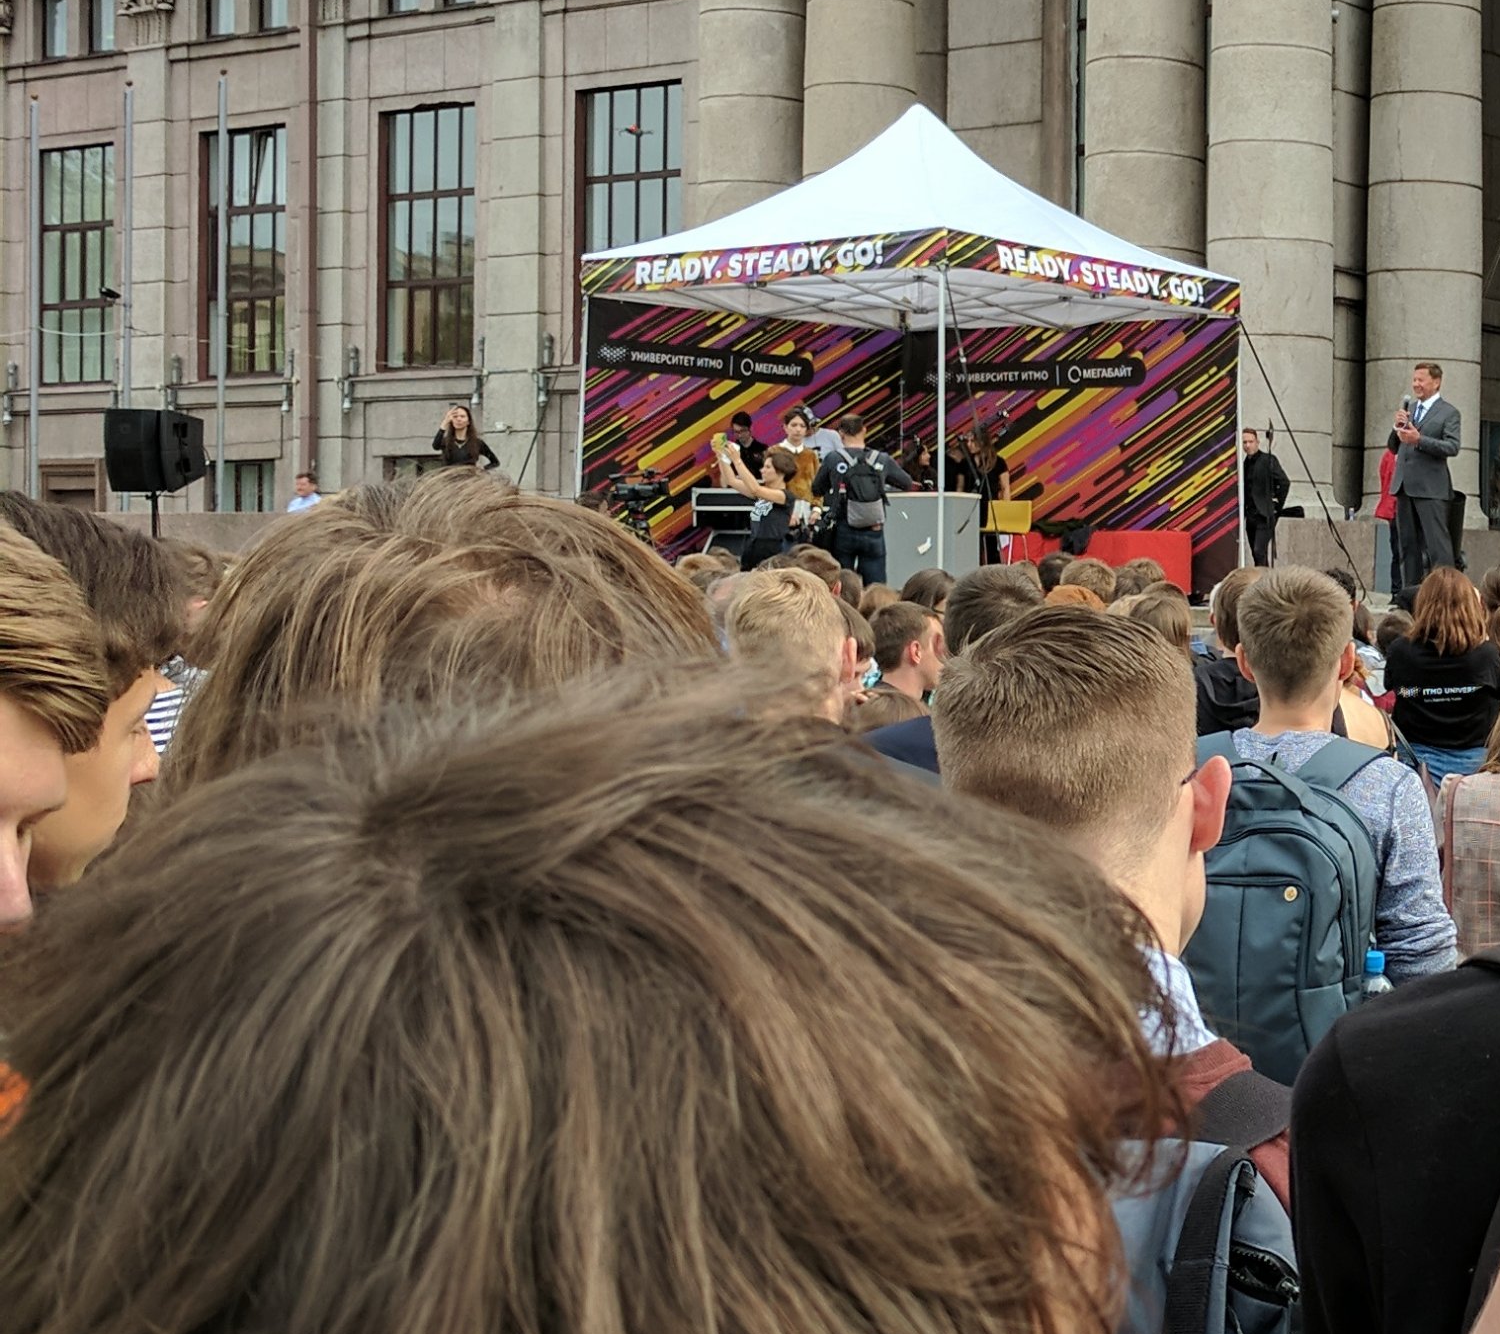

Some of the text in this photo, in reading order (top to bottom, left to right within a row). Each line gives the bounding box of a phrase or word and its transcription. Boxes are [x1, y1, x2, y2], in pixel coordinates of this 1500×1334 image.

[635, 240, 884, 286] READY. STEADY. GO!
[996, 244, 1205, 304] READY. STEADY. GO!
[631, 350, 724, 370] УНИВЕРСИТЕТ ИТМО
[754, 362, 802, 377] МЕГАБАЙТ
[956, 369, 1049, 384] УНИВЕРСИТЕТ ИТМО
[1082, 365, 1133, 380] МЕГАБАЙТ
